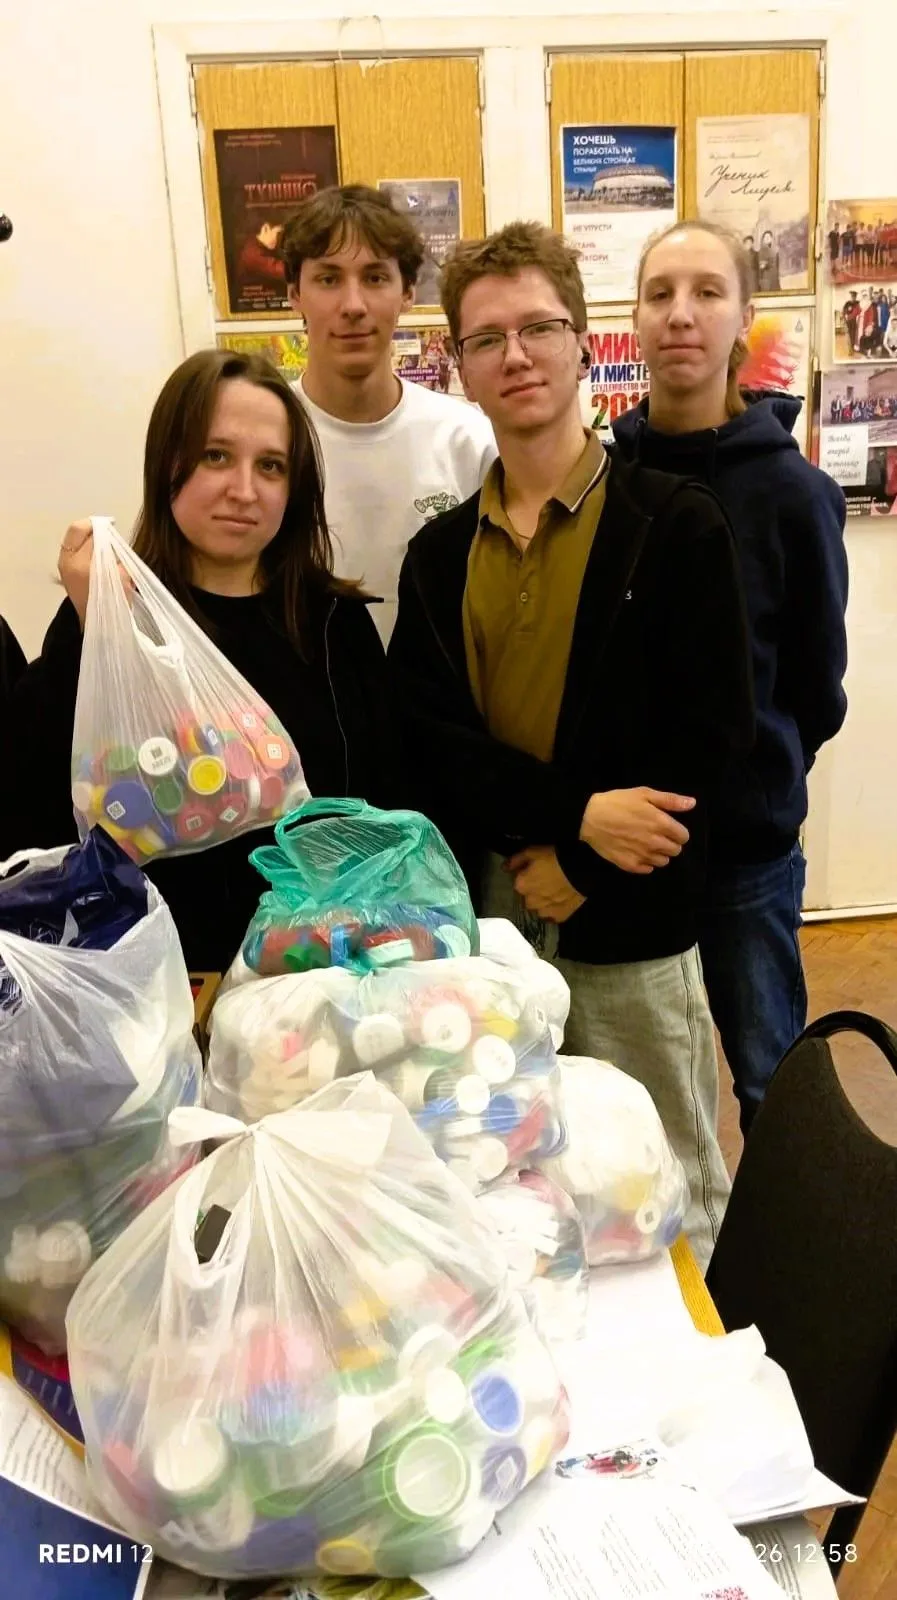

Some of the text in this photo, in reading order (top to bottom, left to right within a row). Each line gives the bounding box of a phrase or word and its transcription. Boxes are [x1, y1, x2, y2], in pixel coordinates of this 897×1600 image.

[573, 136, 616, 145] ХОЧЕШЬ
[573, 146, 633, 156] ПОРАБОТАТЬ НА
[591, 365, 600, 383] И
